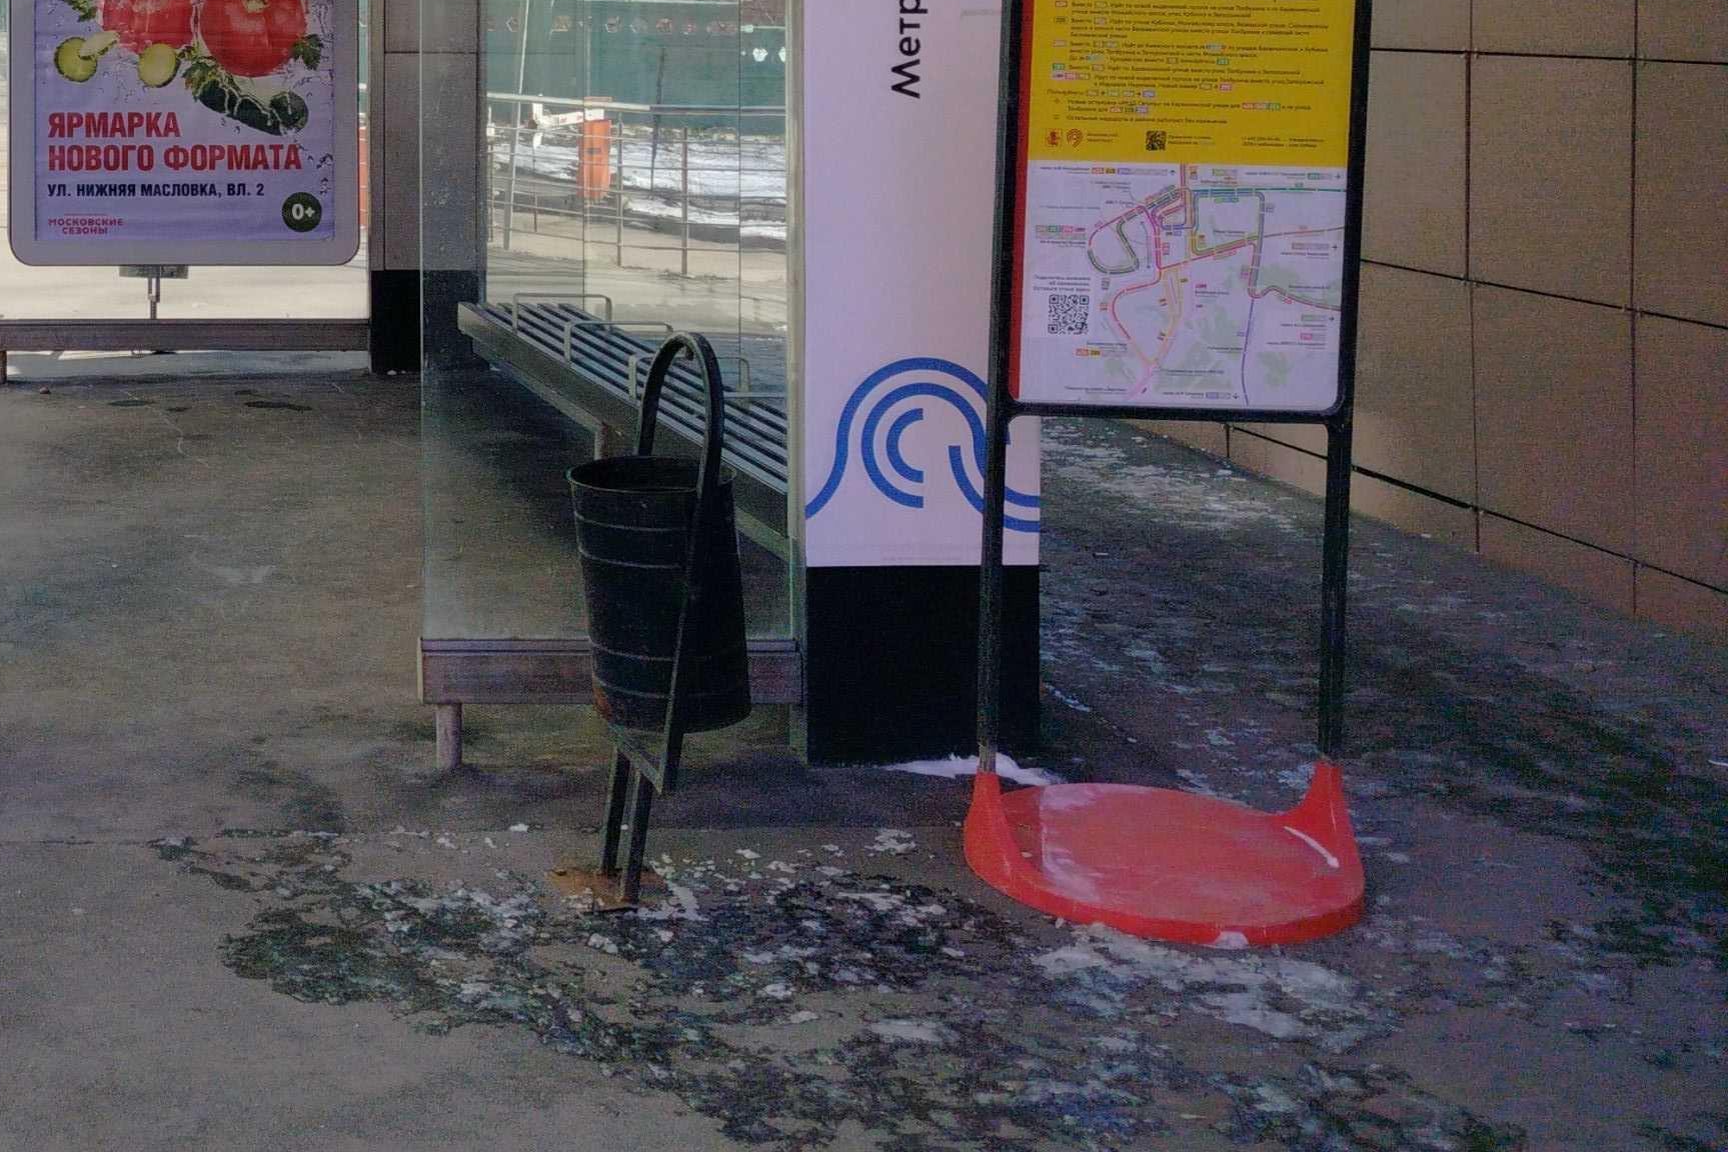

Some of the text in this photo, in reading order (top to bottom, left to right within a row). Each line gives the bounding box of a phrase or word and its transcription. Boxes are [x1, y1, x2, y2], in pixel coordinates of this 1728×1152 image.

[47, 111, 181, 138] ЯРМАРКА
[47, 143, 303, 172] НОВОГО ФОРМАТА
[47, 183, 265, 198] УЛ. НИЖНЯЯ МАСЛОВКА, ВЛ. 2
[290, 203, 316, 221] 0+
[47, 217, 124, 227] МОСКОВСКИЕ
[62, 226, 109, 236] СЕЗОНЫ
